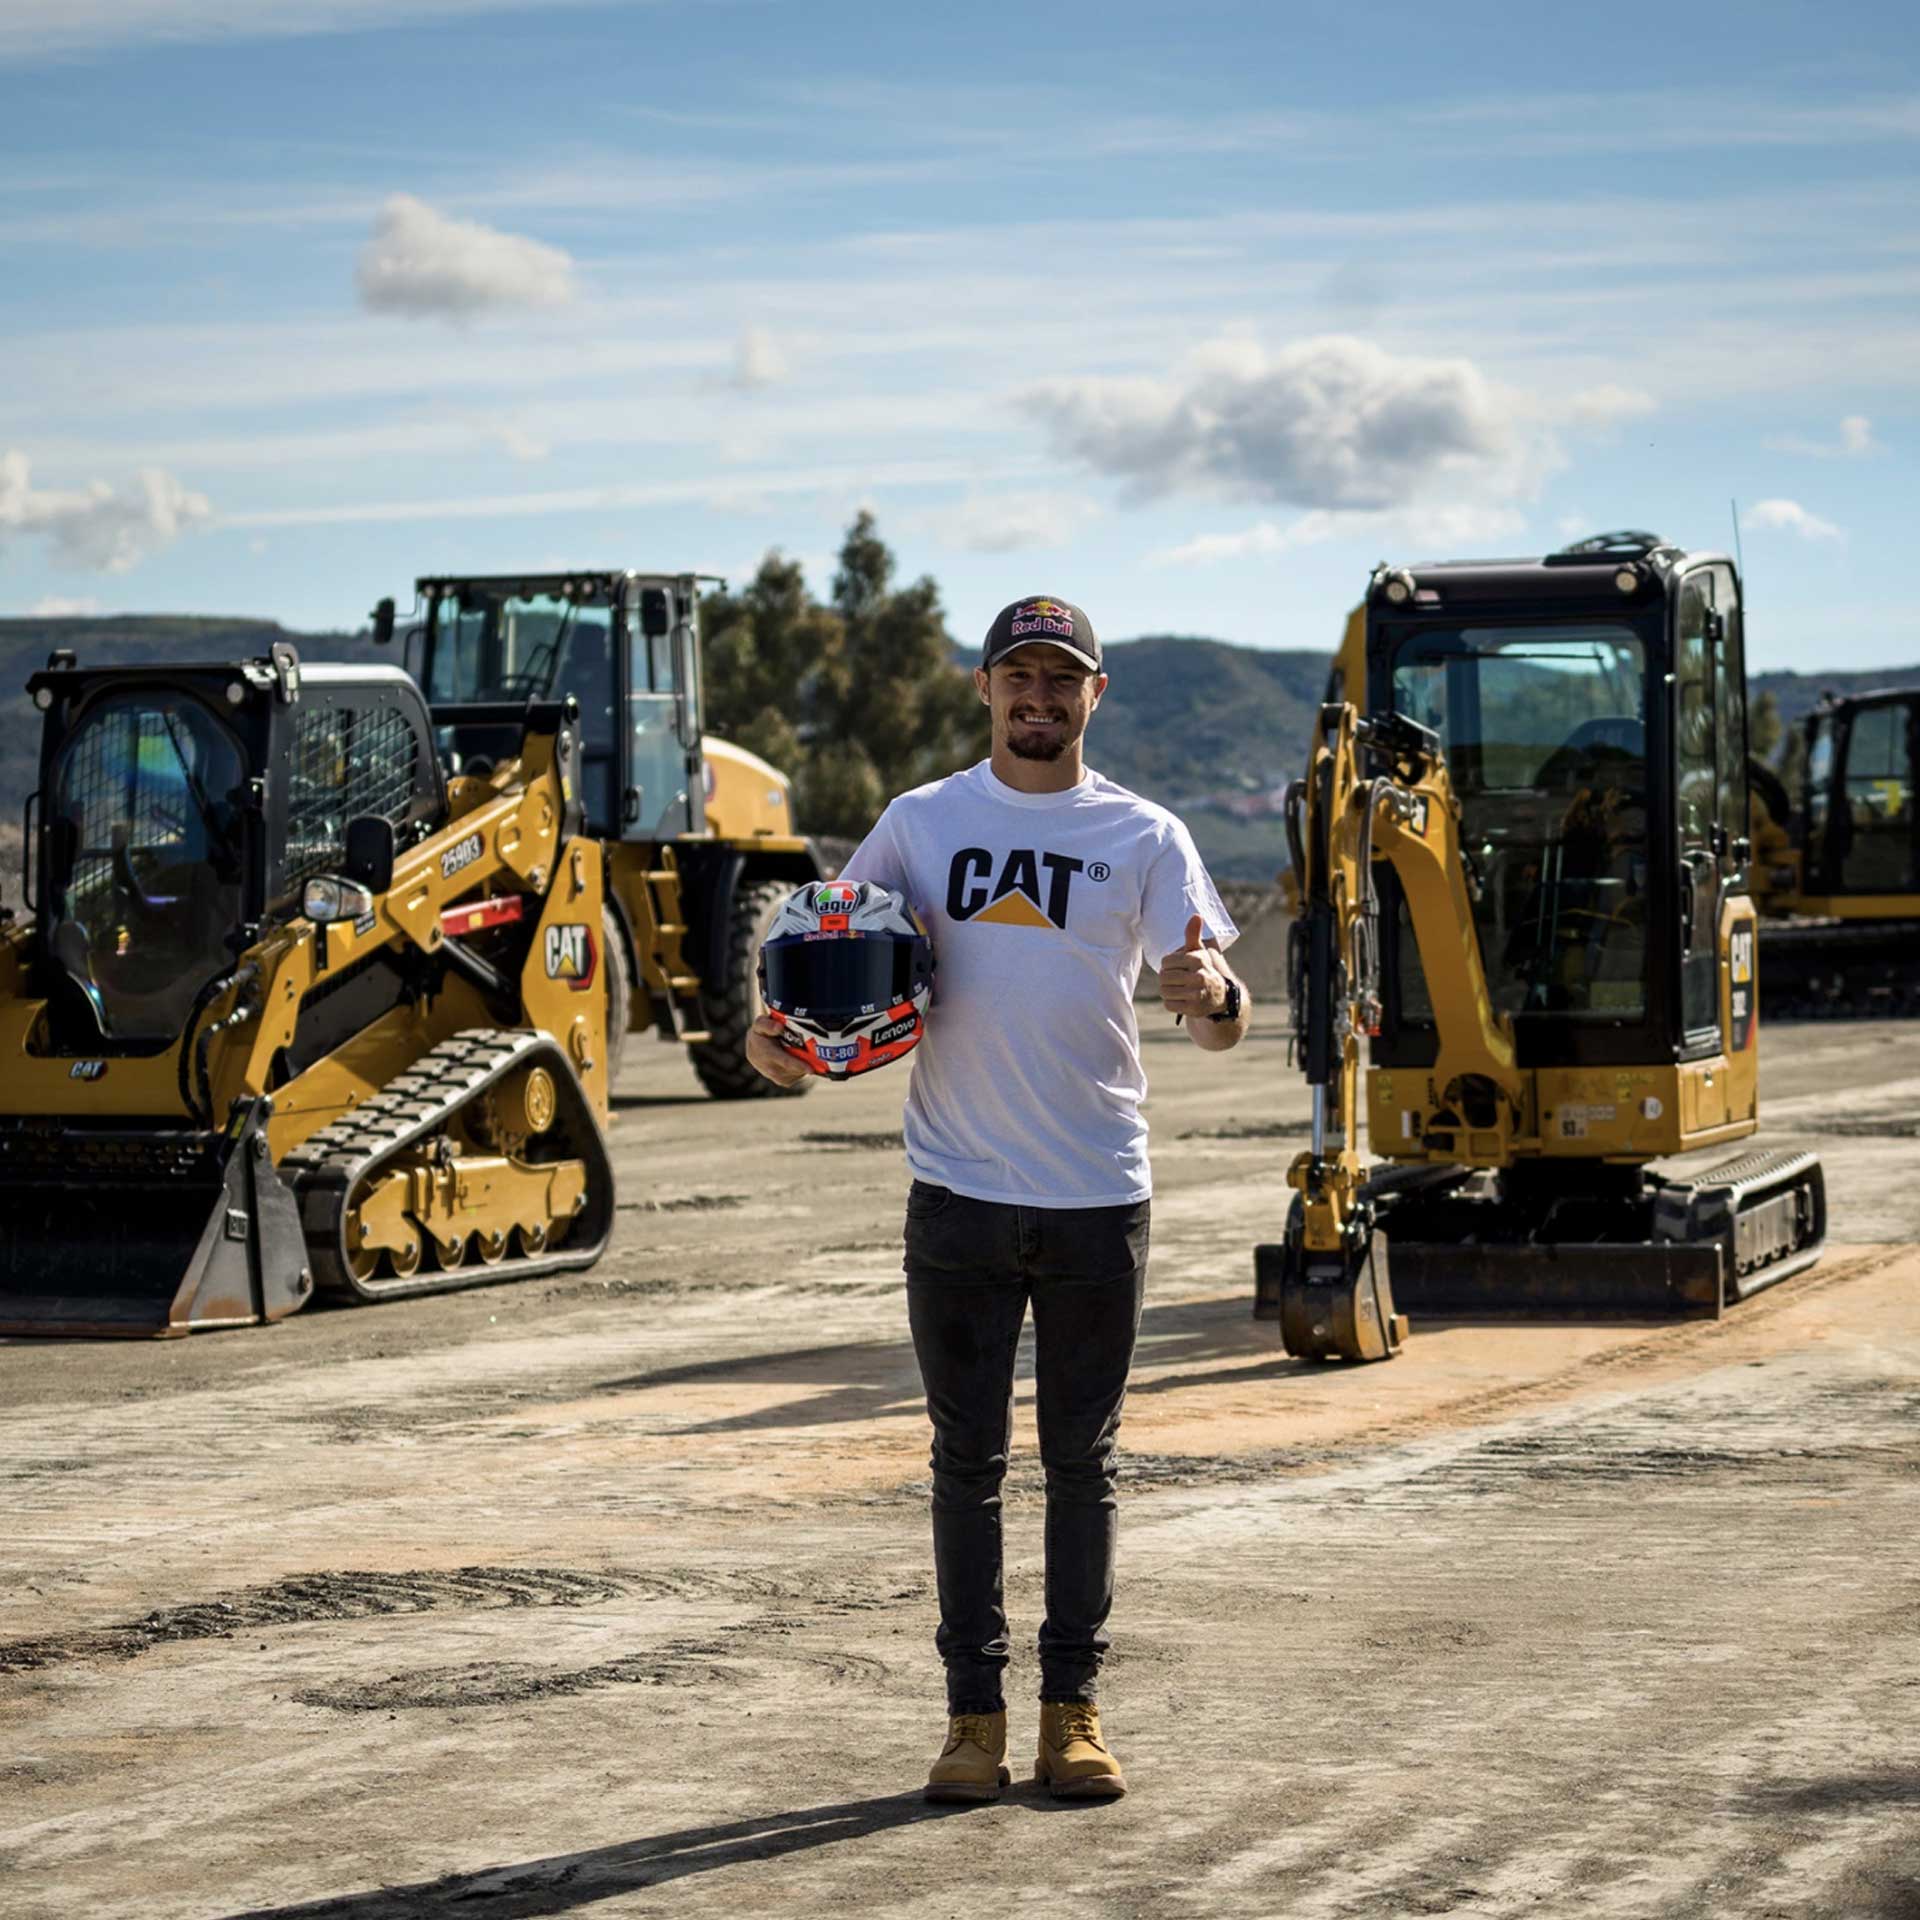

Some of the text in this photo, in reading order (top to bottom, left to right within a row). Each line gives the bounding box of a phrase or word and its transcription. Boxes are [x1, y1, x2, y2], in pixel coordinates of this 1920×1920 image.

[1011, 617, 1073, 636] Red Bull
[946, 847, 1083, 930] CAT
[545, 925, 587, 978] CAT
[70, 1060, 102, 1078] CAT
